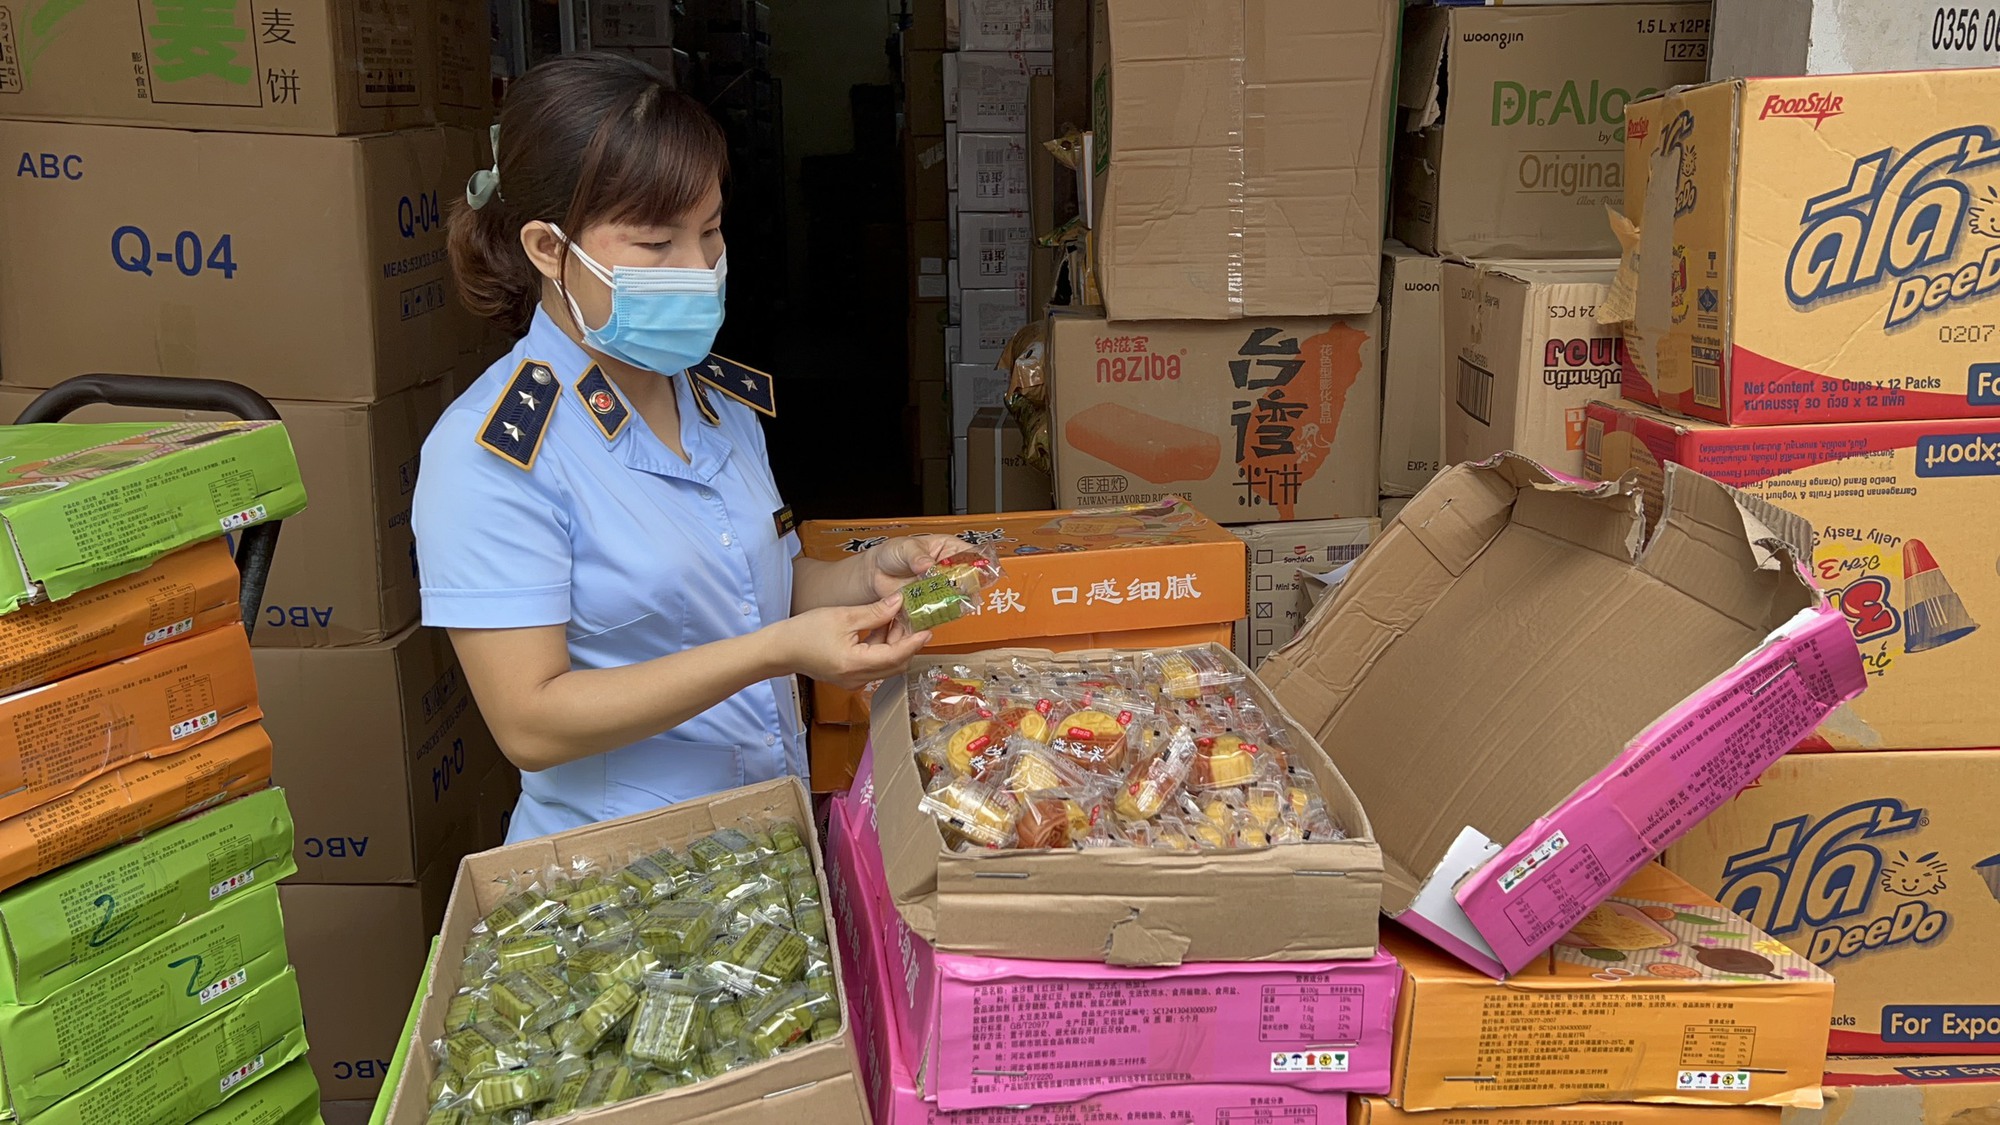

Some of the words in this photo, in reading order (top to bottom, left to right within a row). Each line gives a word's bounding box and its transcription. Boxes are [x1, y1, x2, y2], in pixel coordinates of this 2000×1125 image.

[1637, 19, 1654, 33] 1.5
[1658, 20, 1666, 33] L
[1668, 23, 1677, 32] x
[1931, 7, 1978, 52] 0356
[1463, 32, 1524, 49] woongjin
[132, 52, 147, 98] 膨化食品
[1491, 79, 1659, 127] Dr.Alo
[1598, 130, 1612, 145] by
[17, 153, 83, 180] ABC
[1519, 153, 1624, 197] Origina
[398, 189, 440, 239] Q-04
[111, 225, 238, 279] Q-04
[1546, 305, 1575, 317] PCS.
[1579, 304, 1594, 316] 24
[1939, 324, 1994, 343] 0207
[1095, 336, 1149, 354] 纳滋宝
[1096, 352, 1182, 383] naziba
[1744, 381, 1764, 395] Net
[1768, 381, 1815, 394] Content
[1822, 380, 1838, 392] 30
[1842, 379, 1877, 394] Cups
[1876, 381, 1883, 390] x
[1888, 378, 1900, 390] 12
[1905, 376, 1941, 389] Packs
[1228, 327, 1310, 463] 台湾
[1805, 397, 1821, 409] 30
[1853, 398, 1861, 407] x
[1865, 396, 1878, 406] 12
[1407, 461, 1428, 471] EXP:
[1432, 461, 1439, 471] 2
[1743, 466, 1774, 476] Yoghurt
[1777, 466, 1791, 476] and
[1079, 475, 1126, 493] 非油炸
[1764, 478, 1806, 489] Flavoured,
[1808, 475, 1840, 486] (Orange
[1842, 476, 1867, 485] Brand
[1869, 475, 1895, 484] DeeDo
[1077, 493, 1151, 505] TAIWAN-FLAVORED
[1764, 487, 1797, 499] Yoghurt
[1798, 490, 1805, 499] &
[1808, 489, 1831, 499] Fruits
[1833, 487, 1864, 498] Dessert
[1866, 486, 1916, 497] Carrageenan
[1822, 525, 1861, 540] Tasty
[1865, 527, 1901, 547] Jelly
[1816, 557, 1838, 579] 3
[1050, 573, 1202, 607] 口感细腻
[265, 605, 333, 628] ABC
[432, 737, 464, 804] Q-04
[303, 836, 369, 858] ABC
[89, 893, 140, 948] 2
[1806, 900, 1952, 966] DeeDo
[1296, 974, 1330, 983] 营养成分表
[1891, 1013, 1930, 1035] For
[1907, 1068, 1951, 1078] For
